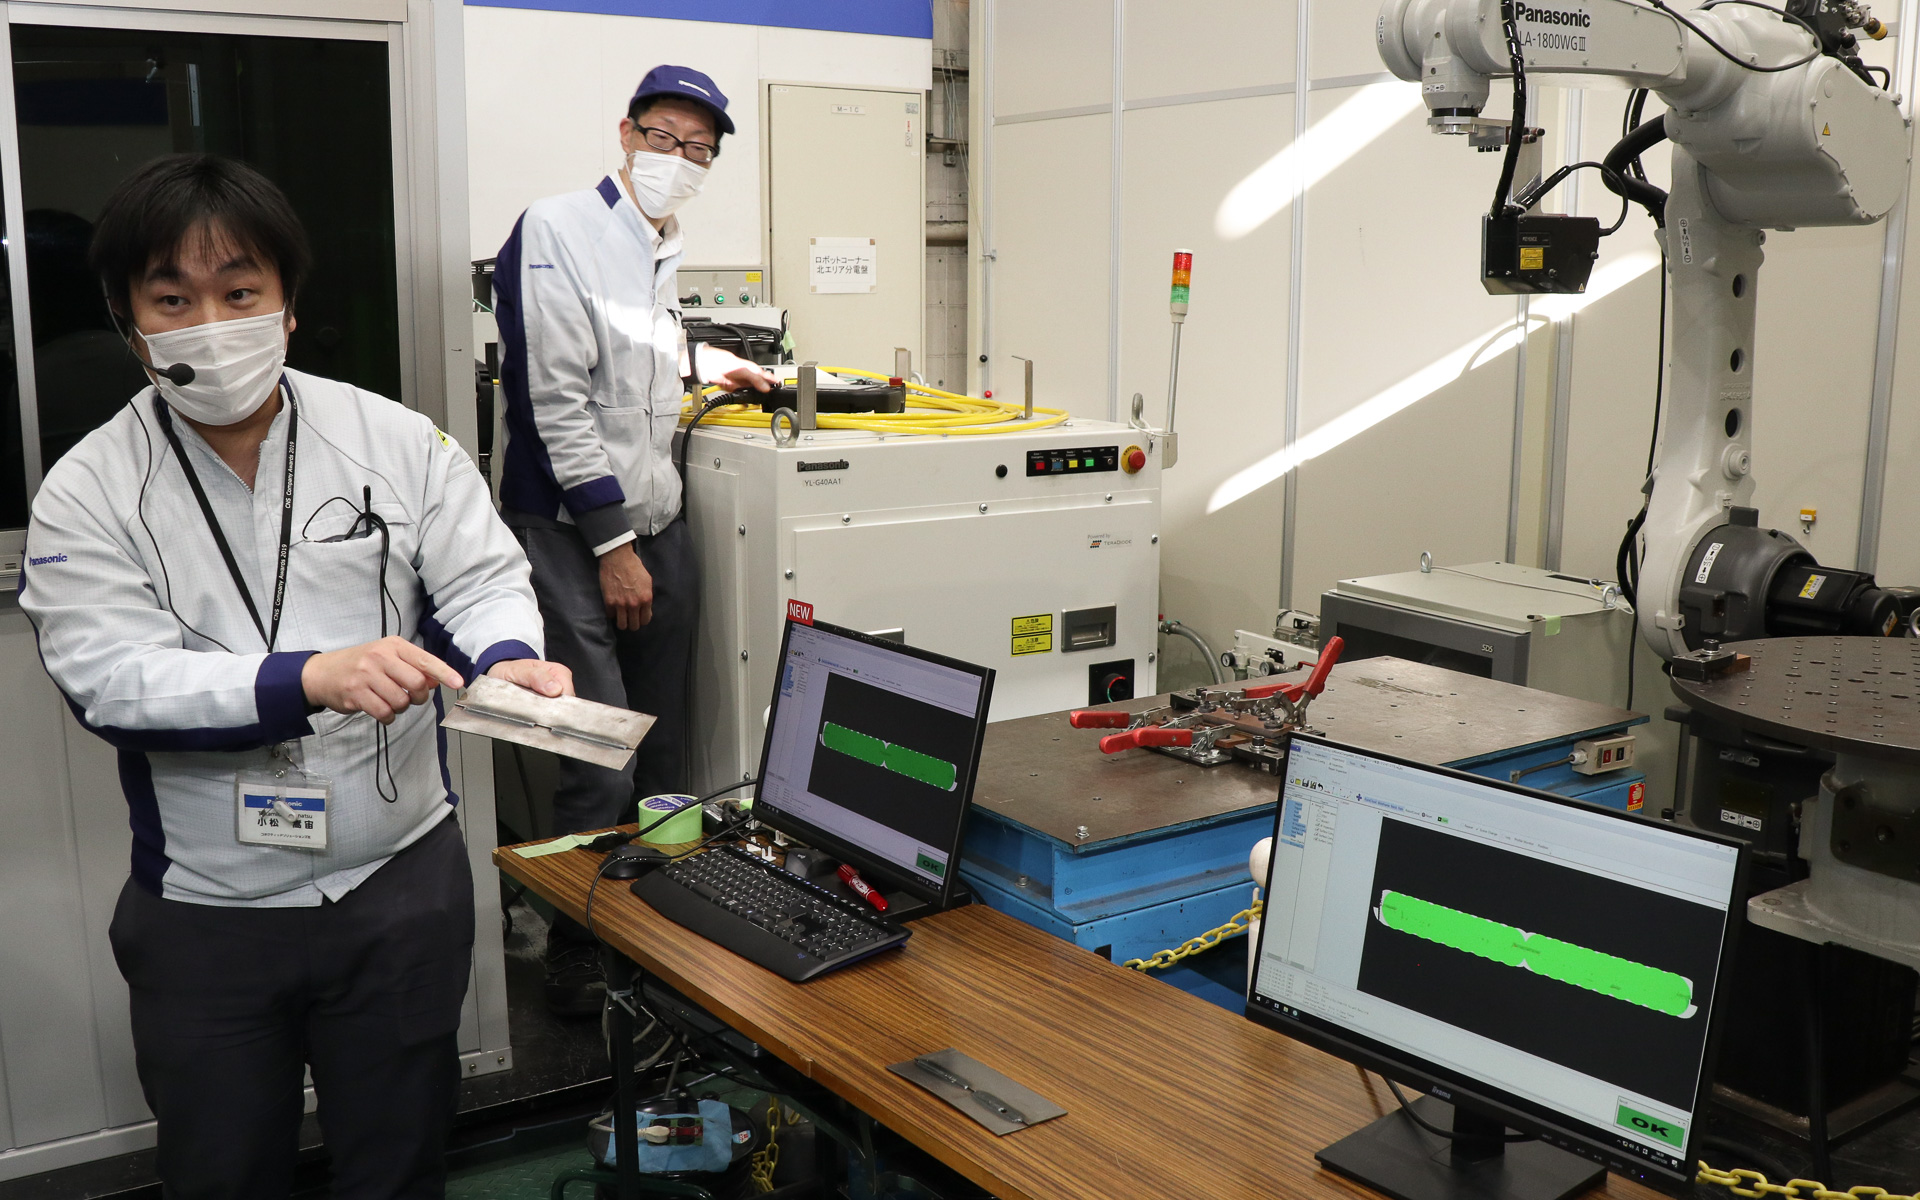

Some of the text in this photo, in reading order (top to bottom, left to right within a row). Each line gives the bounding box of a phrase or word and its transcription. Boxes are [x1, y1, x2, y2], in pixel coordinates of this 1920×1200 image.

[1515, 2, 1591, 28] Panasonic
[815, 255, 870, 264] ロボットコーナー
[816, 265, 868, 275] 北エリア分電盤
[796, 458, 850, 473] Panasonic
[284, 440, 296, 509] CNS Company Awards 2019
[804, 478, 841, 487] YL-G40AA1
[273, 543, 288, 621] CNS Company Awards 2019
[789, 602, 811, 621] NEW
[1481, 644, 1493, 653] SDS
[922, 860, 939, 872] OK
[1631, 1117, 1669, 1138] OK
